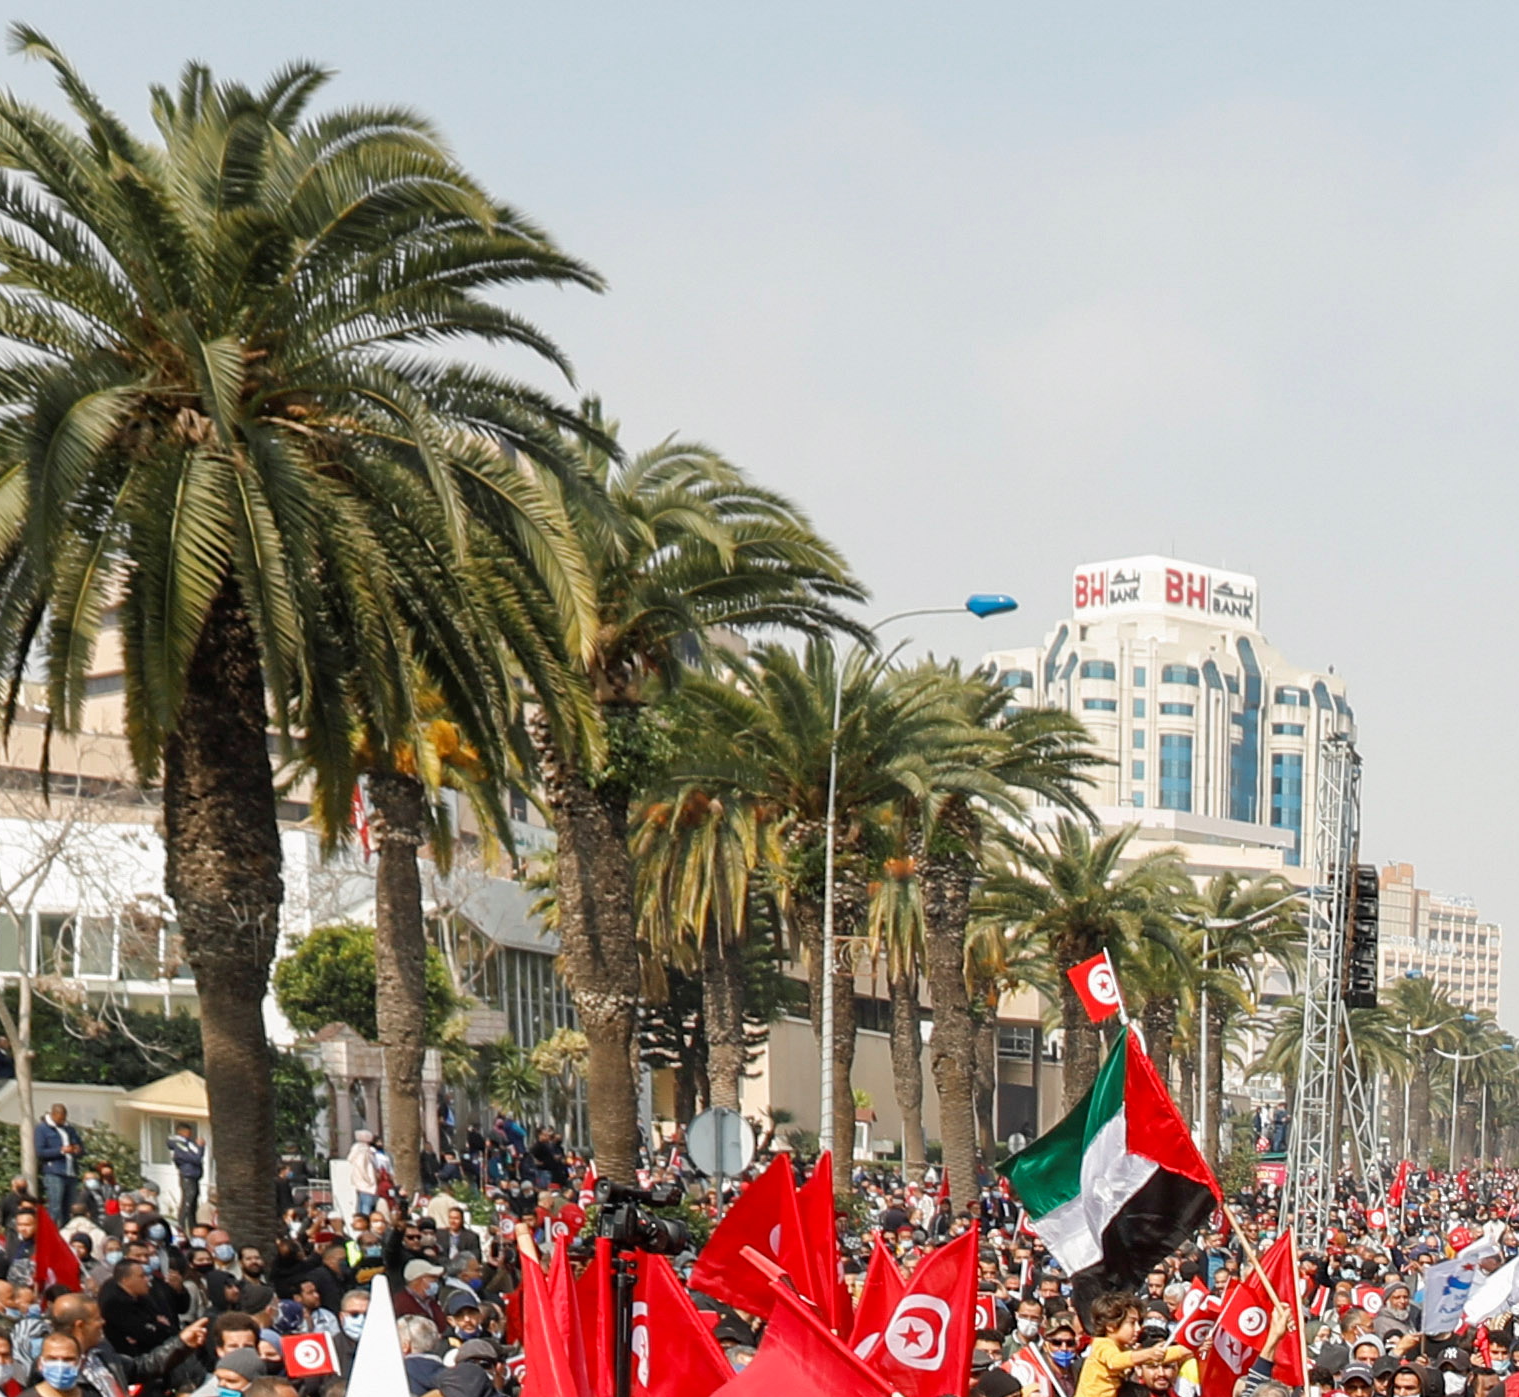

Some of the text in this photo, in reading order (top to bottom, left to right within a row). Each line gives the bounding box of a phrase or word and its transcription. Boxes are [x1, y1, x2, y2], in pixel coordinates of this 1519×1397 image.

[1075, 574, 1105, 609] BH
[1110, 586, 1140, 605] BANK
[1165, 568, 1207, 611] BH
[1213, 597, 1254, 621] BANK
